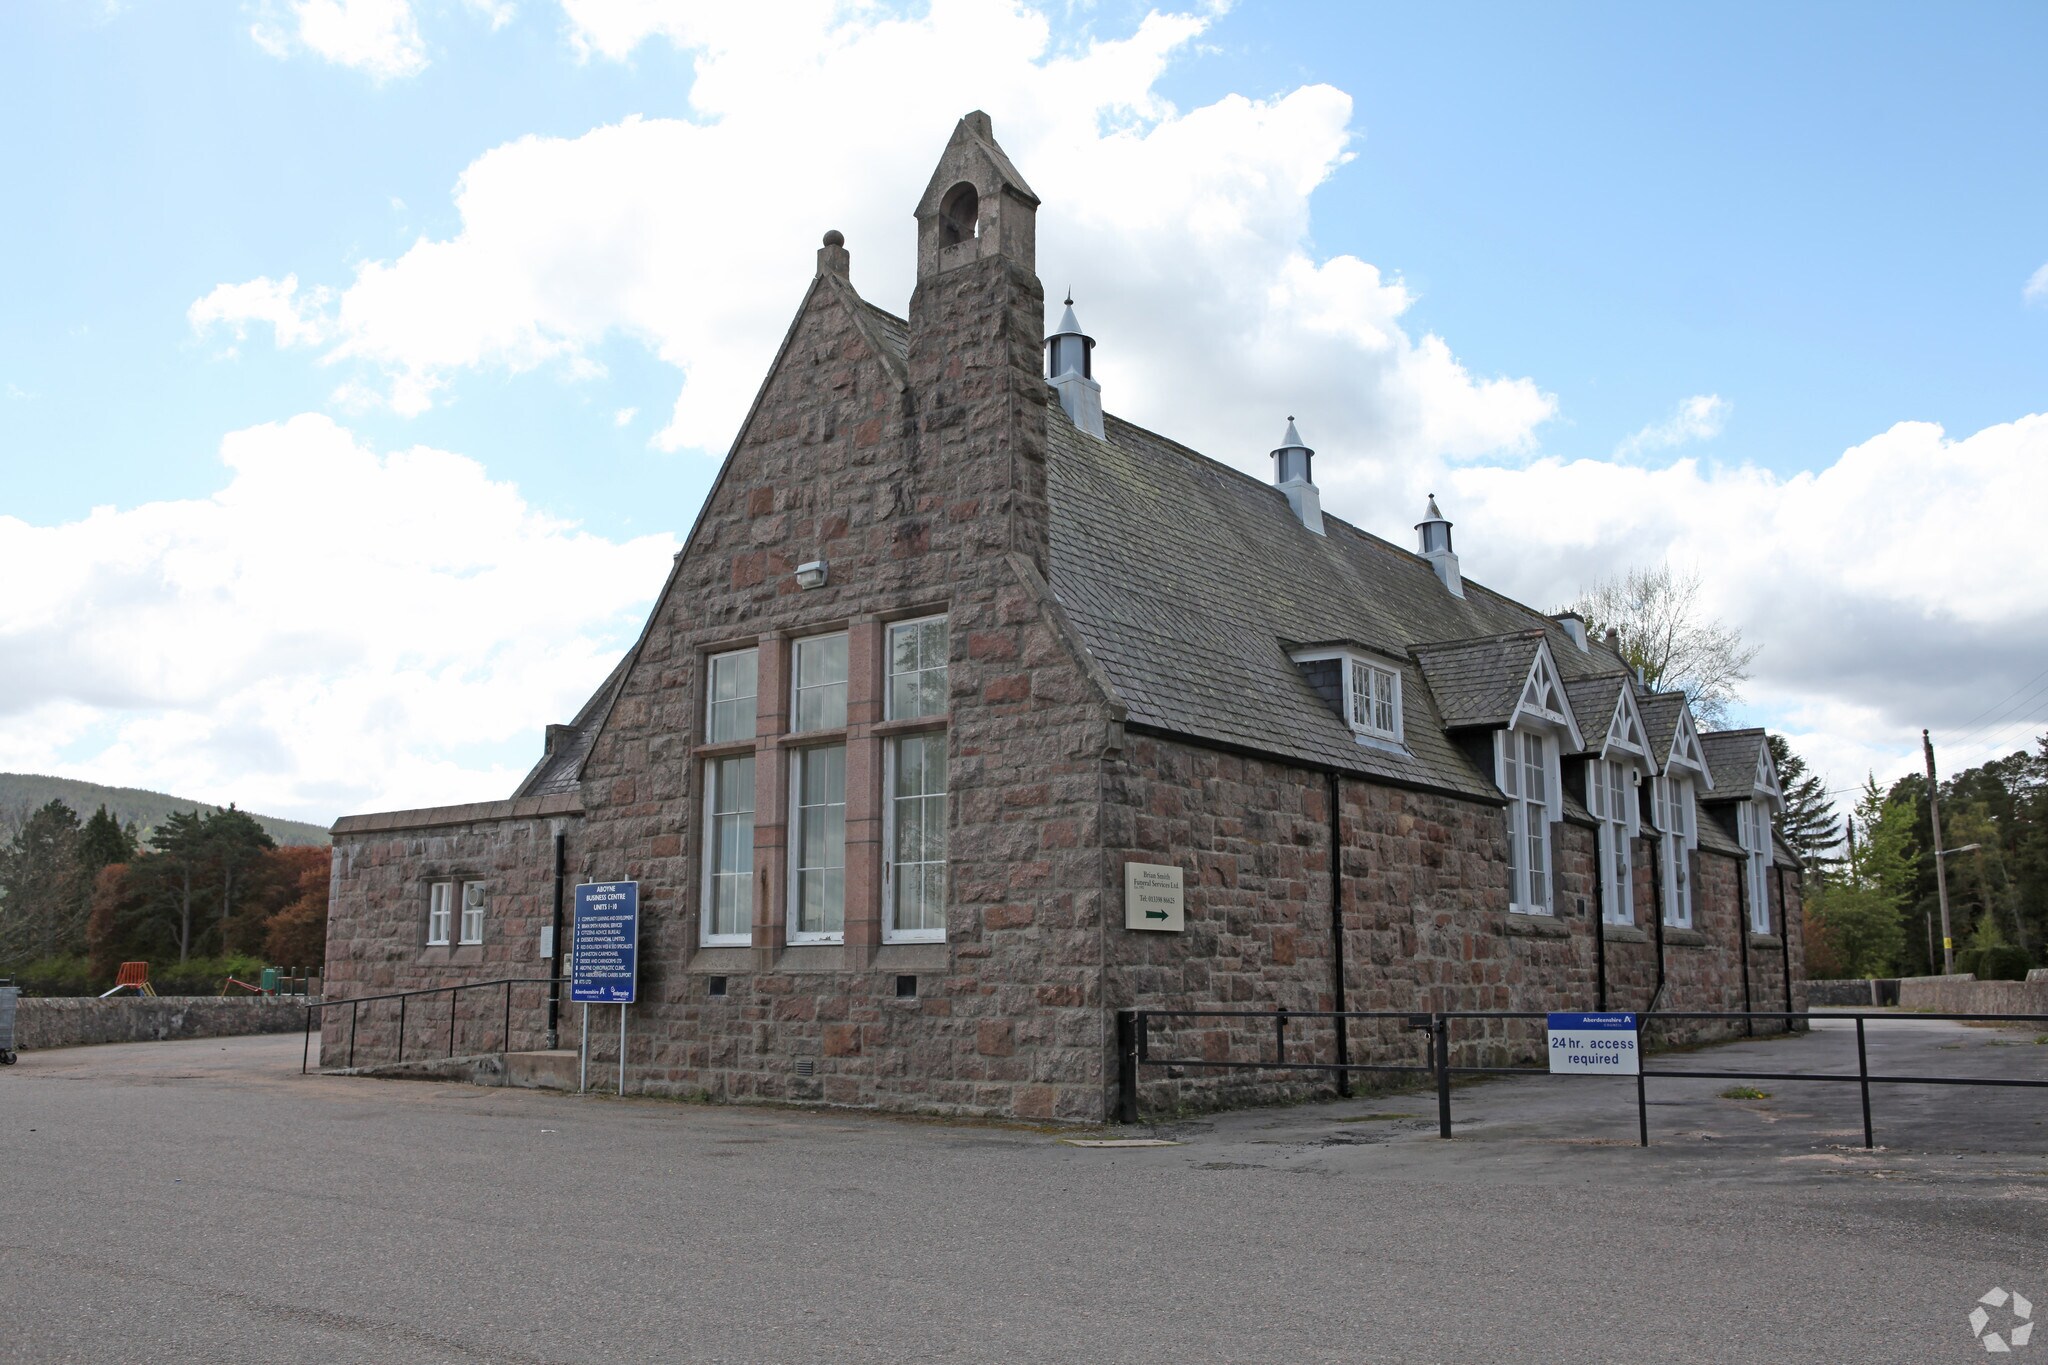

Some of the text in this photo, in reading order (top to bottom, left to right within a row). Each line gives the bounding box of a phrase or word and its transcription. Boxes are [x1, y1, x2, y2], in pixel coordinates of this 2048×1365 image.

[1134, 878, 1151, 886] Funeral
[1152, 880, 1170, 888] Services
[1552, 1037, 1634, 1049] 24 hr. access
[1568, 1053, 1619, 1066] required
